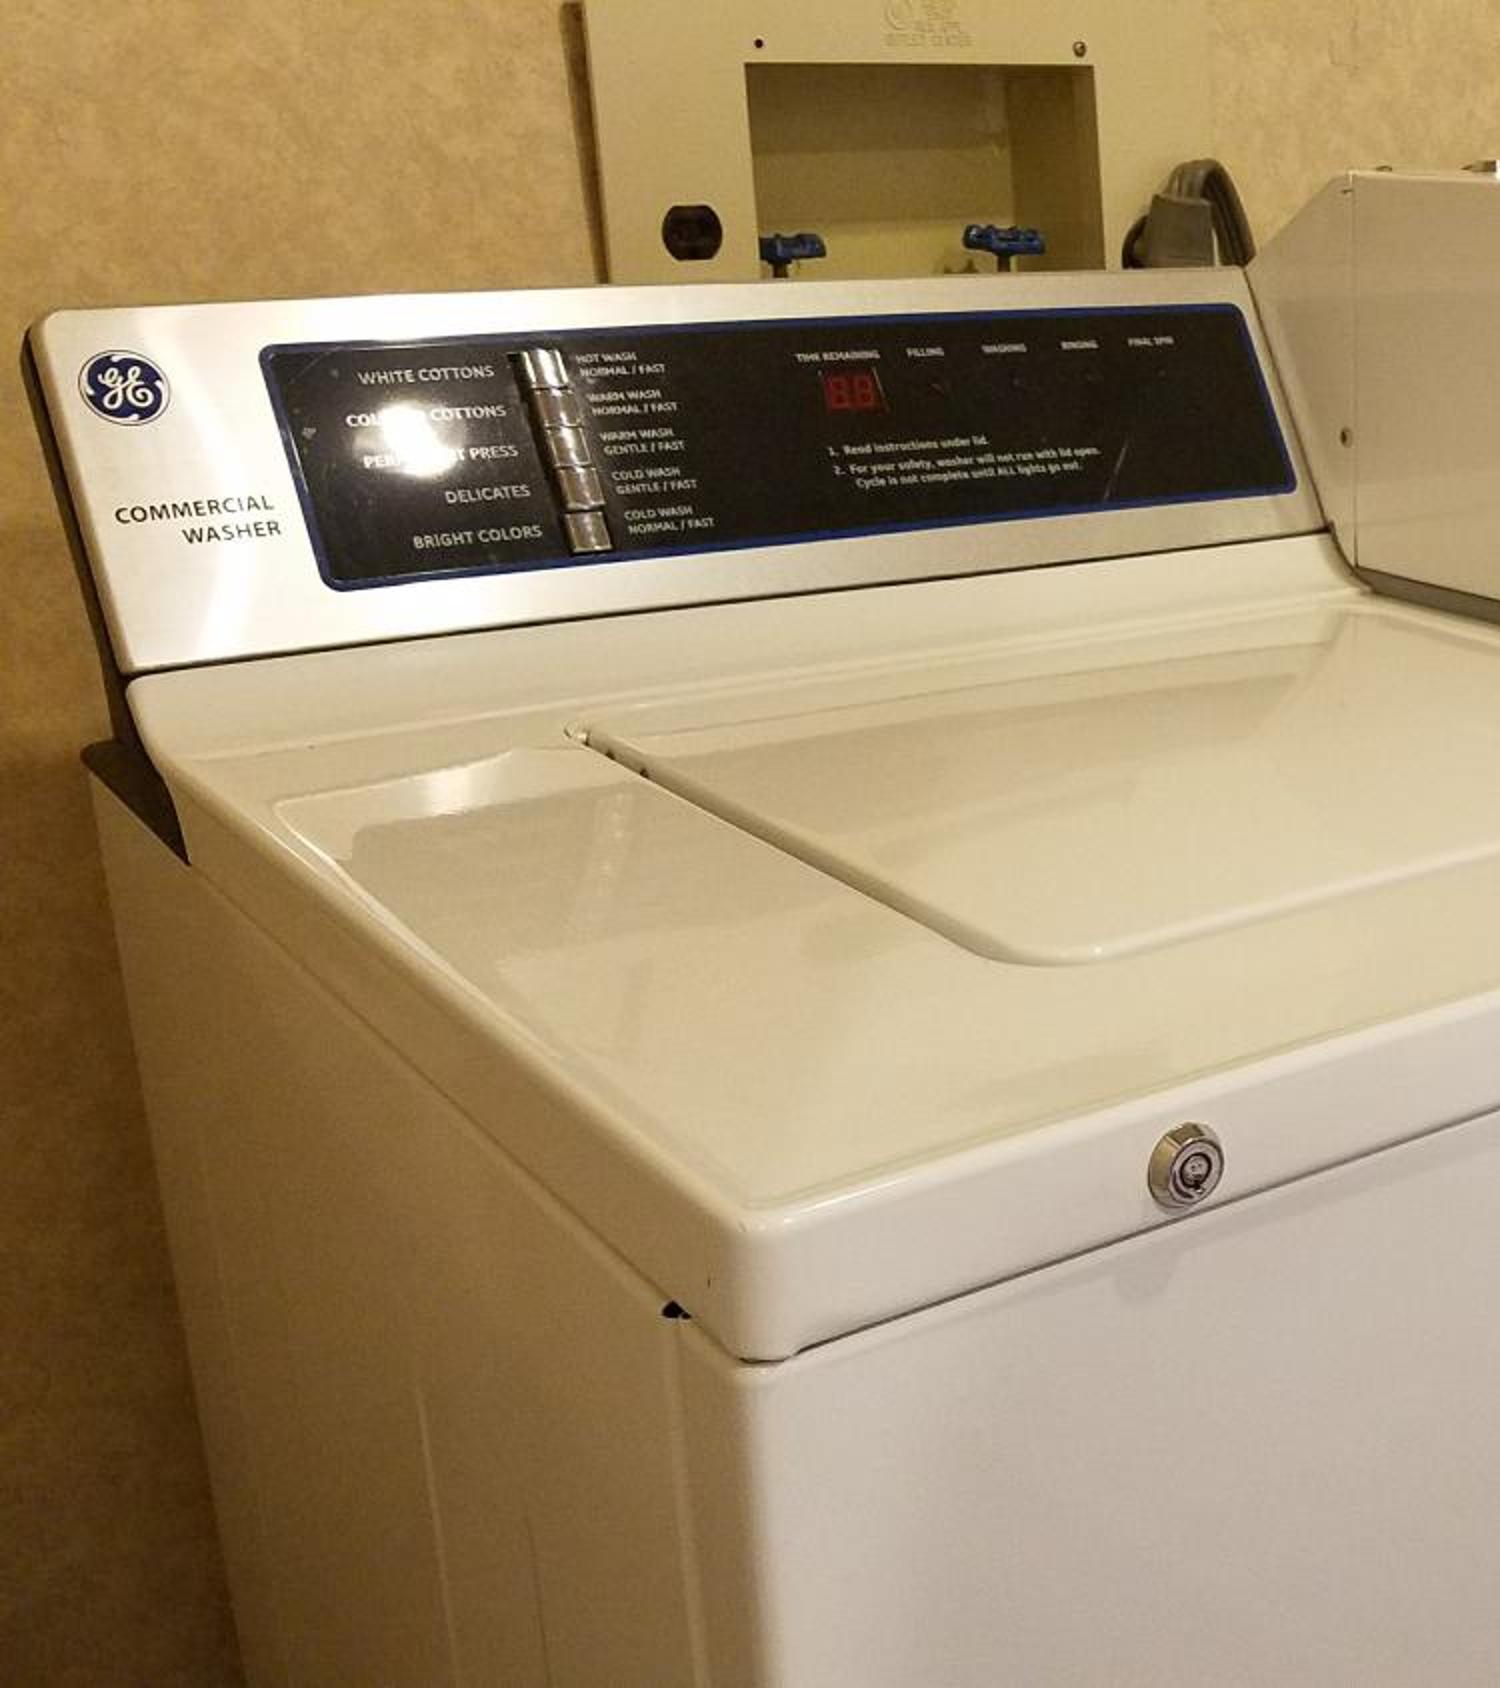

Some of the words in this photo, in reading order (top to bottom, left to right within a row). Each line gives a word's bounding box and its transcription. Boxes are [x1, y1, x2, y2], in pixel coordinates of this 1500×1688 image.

[576, 353, 600, 363] HOT
[602, 351, 637, 362] WASH
[823, 350, 880, 361] REMAINING
[905, 347, 945, 357] FILLING
[358, 369, 416, 385] WHITE
[418, 365, 495, 382] COTTONS
[579, 365, 630, 377] NORMAL
[640, 363, 666, 375] FAST
[586, 391, 626, 402] WARM
[626, 389, 662, 400] WASH
[430, 405, 507, 421] COTTONS
[592, 404, 642, 416] NORMAL
[651, 401, 678, 413] FAST
[600, 430, 638, 441] WARM
[639, 427, 675, 439] WASH
[469, 446, 519, 460] PRESS
[603, 443, 648, 455] GENTLE
[658, 440, 685, 452] FAST
[843, 444, 873, 454] Read
[873, 440, 939, 453] instructions
[611, 469, 644, 481] COLD
[645, 467, 681, 478] WASH
[616, 483, 660, 495] GENTLE
[669, 479, 698, 491] FAST
[856, 476, 887, 490] Cycle
[445, 484, 531, 503] DELICATES
[115, 495, 274, 524] COMMERCIAL
[623, 508, 657, 520] COLD
[657, 505, 693, 517] WASH
[182, 521, 281, 545] WASHER
[628, 521, 679, 535] NORMAL
[687, 517, 715, 529] FAST
[413, 532, 474, 549] BRIGHT
[477, 525, 543, 543] COLORS
